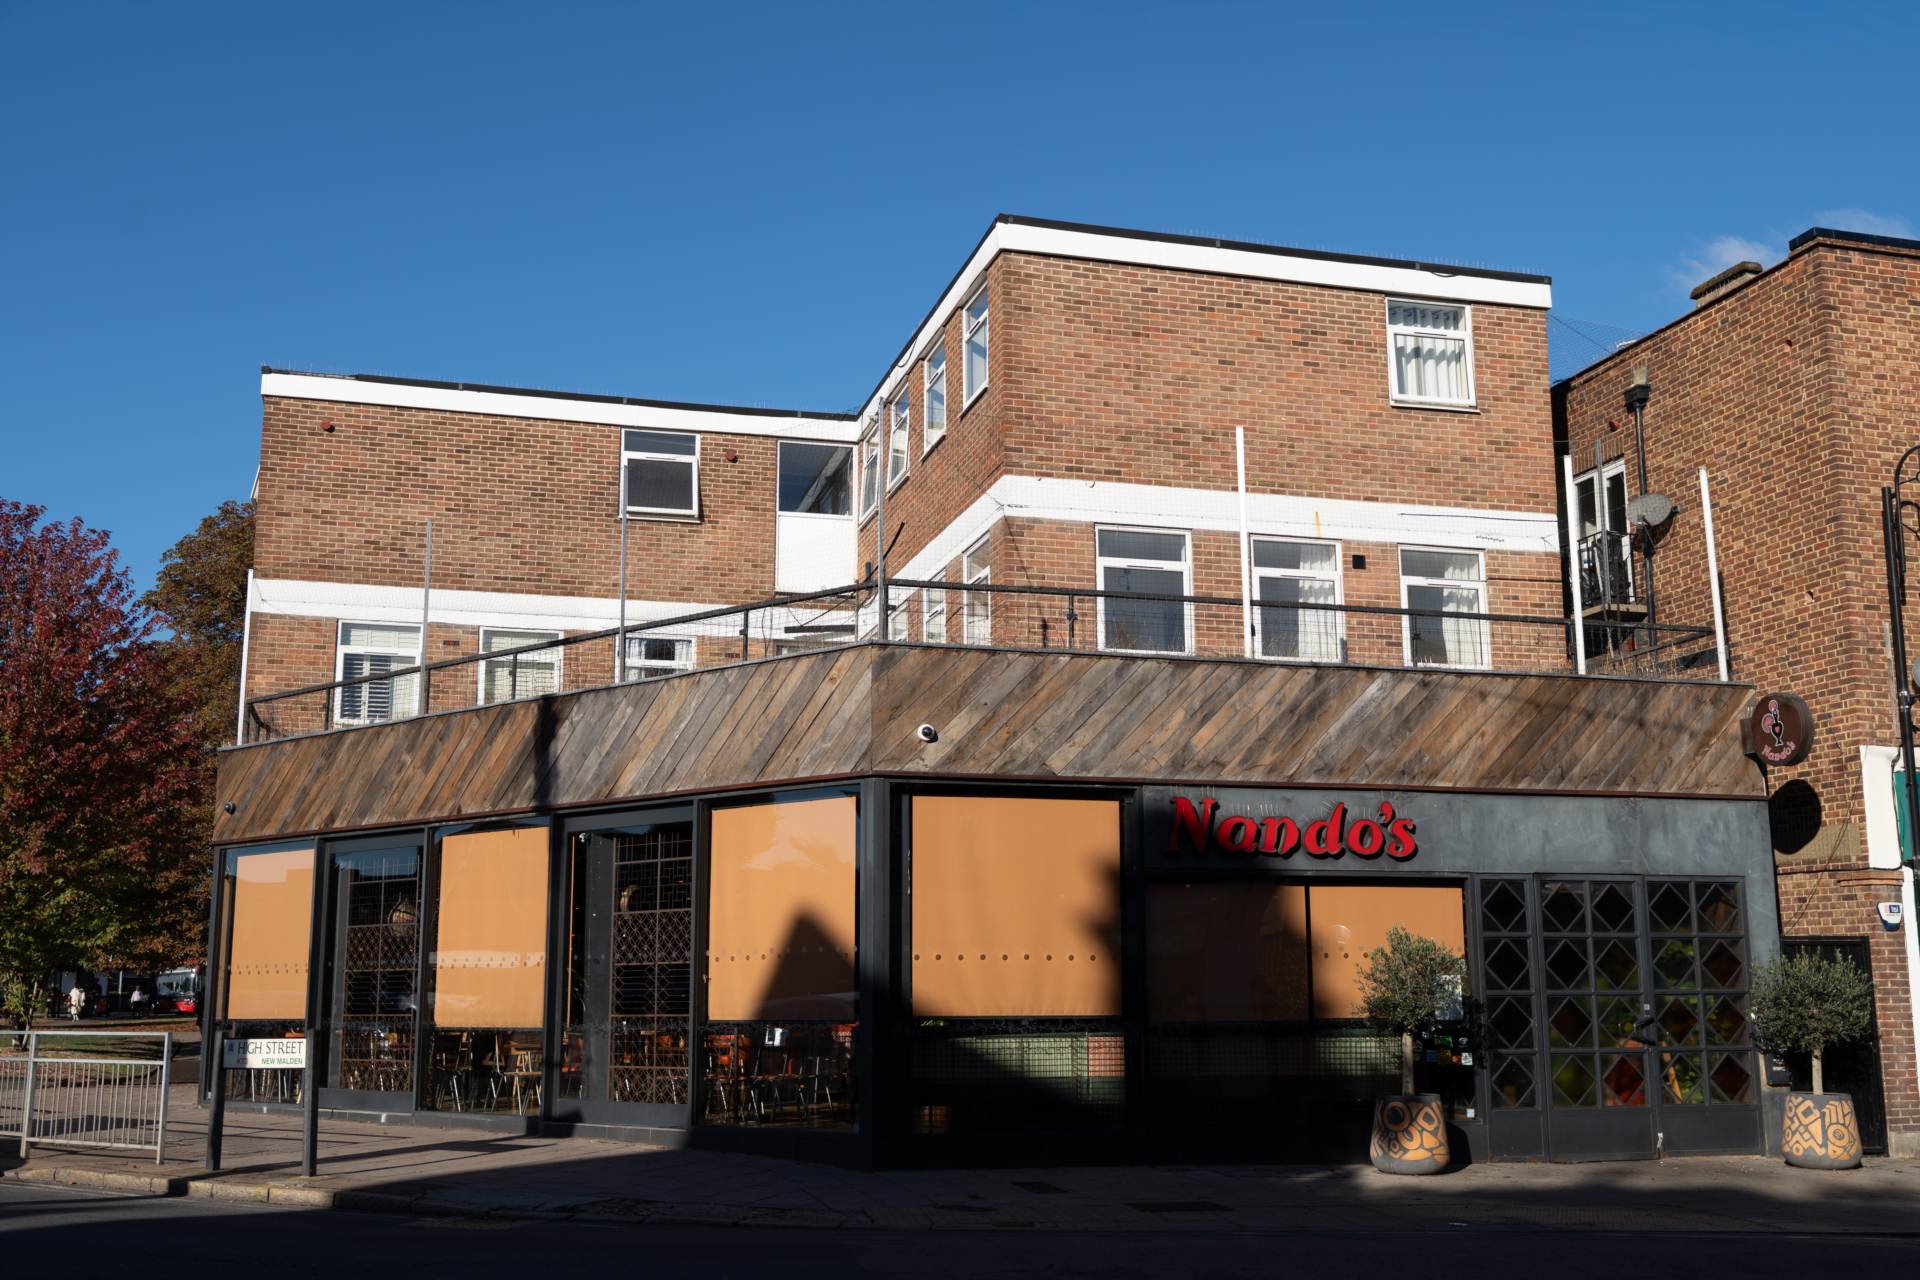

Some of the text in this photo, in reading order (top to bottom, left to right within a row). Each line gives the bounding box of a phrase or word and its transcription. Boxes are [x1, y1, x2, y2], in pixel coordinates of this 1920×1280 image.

[1168, 796, 1417, 858] Nando's
[238, 1041, 304, 1055] HIGH STREET
[261, 1057, 303, 1065] NEW MALDEN
